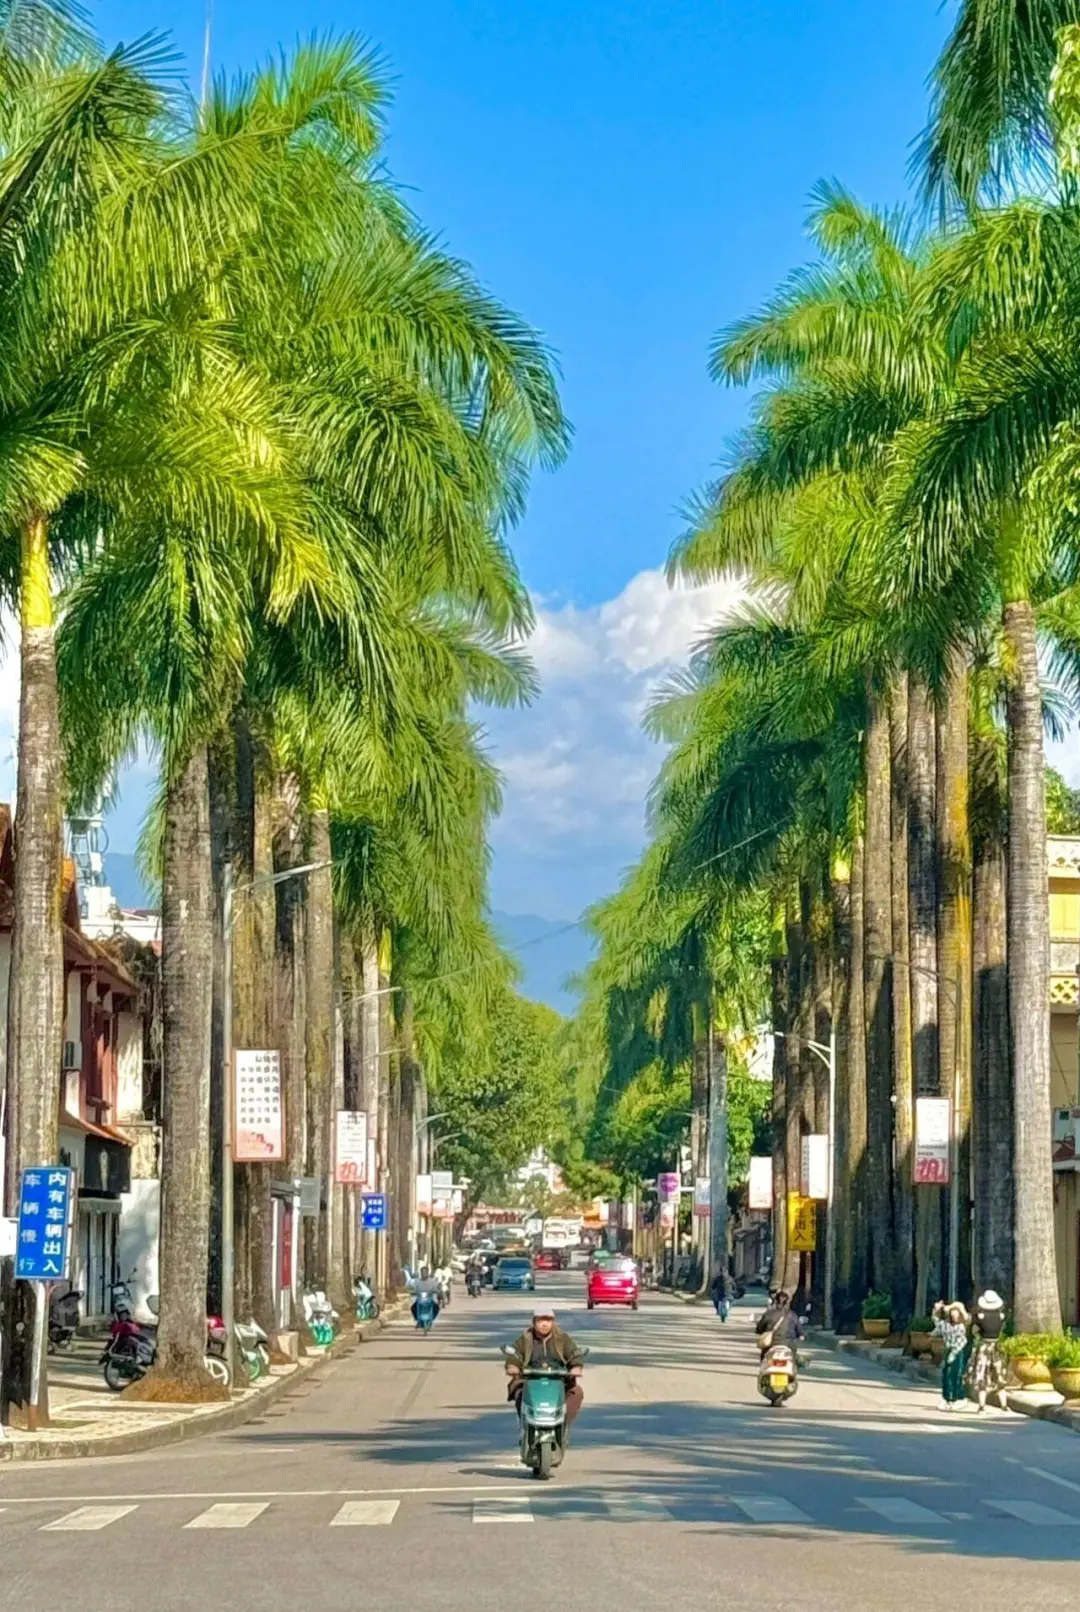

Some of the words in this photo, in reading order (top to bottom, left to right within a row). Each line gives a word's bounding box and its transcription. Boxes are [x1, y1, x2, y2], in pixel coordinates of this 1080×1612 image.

[19, 1173, 41, 1271] 车辆慢行
[42, 1172, 67, 1274] 内有车辆出入
